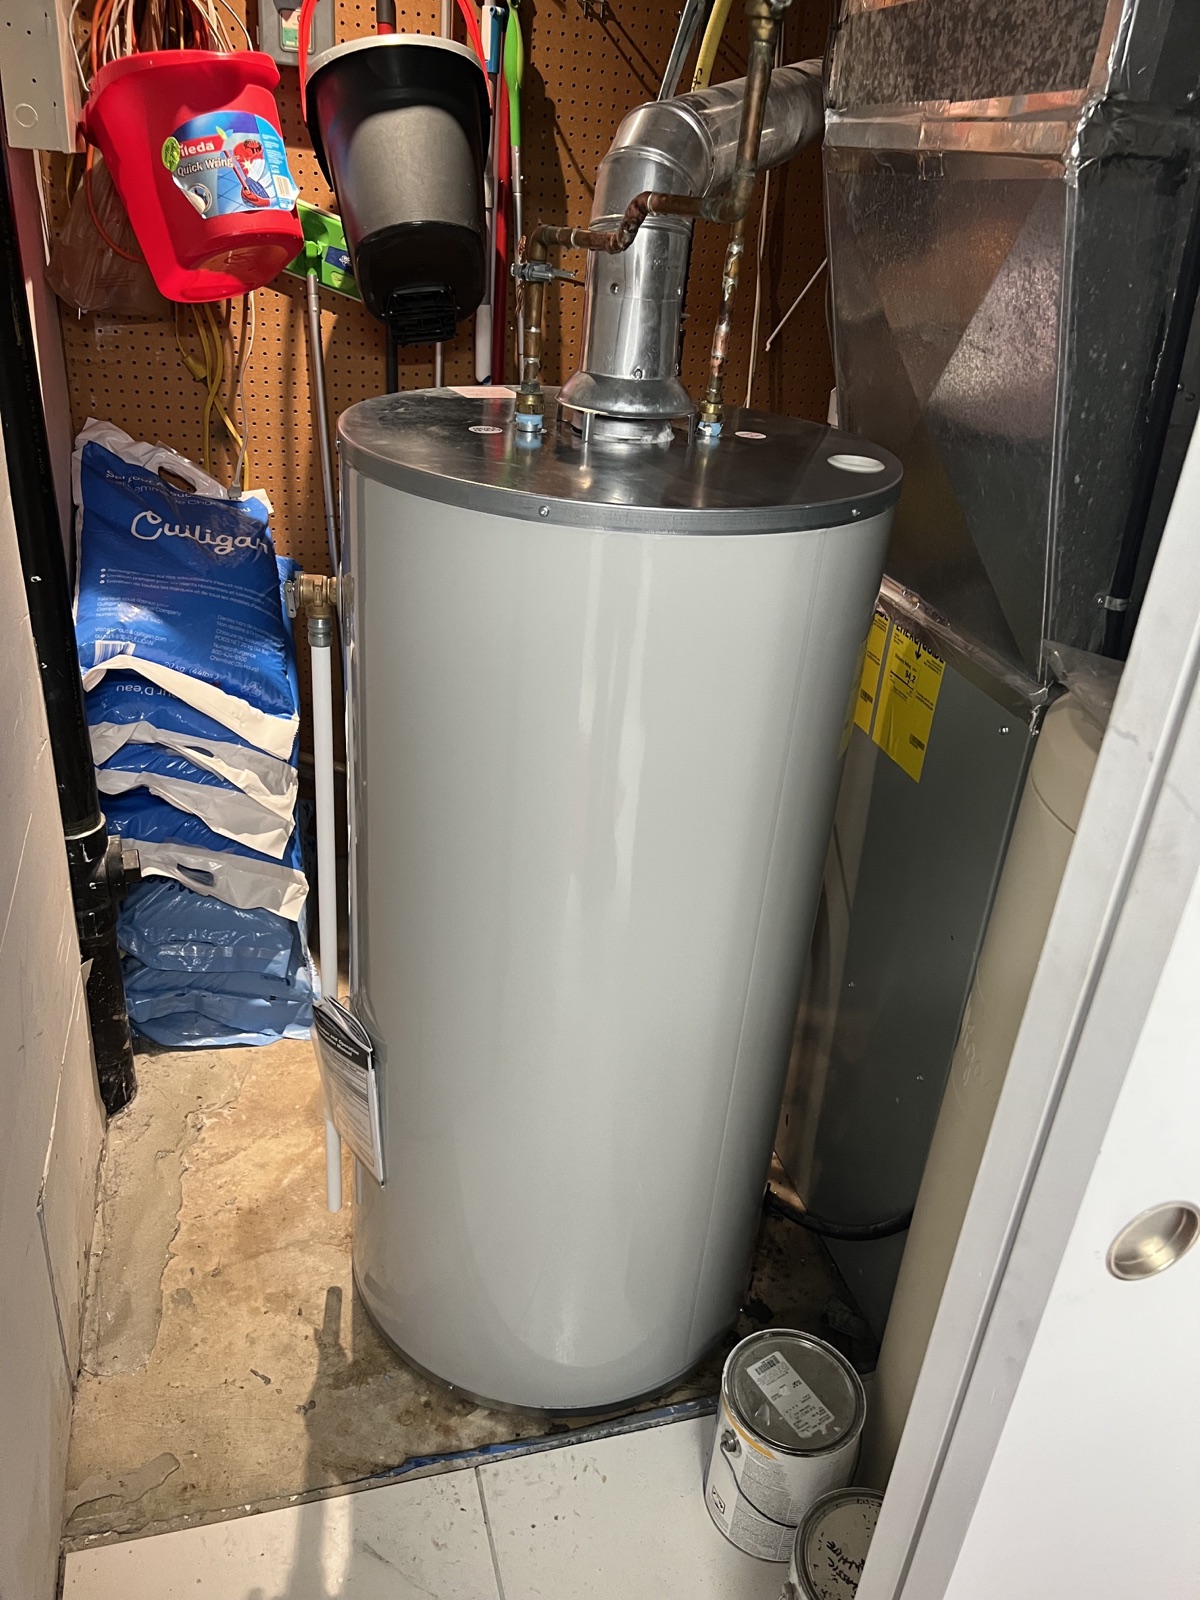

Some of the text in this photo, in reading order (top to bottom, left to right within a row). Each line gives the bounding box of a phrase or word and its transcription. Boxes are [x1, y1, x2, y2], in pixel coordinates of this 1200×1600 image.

[179, 141, 215, 157] ileda
[177, 158, 234, 177] Quick Wring
